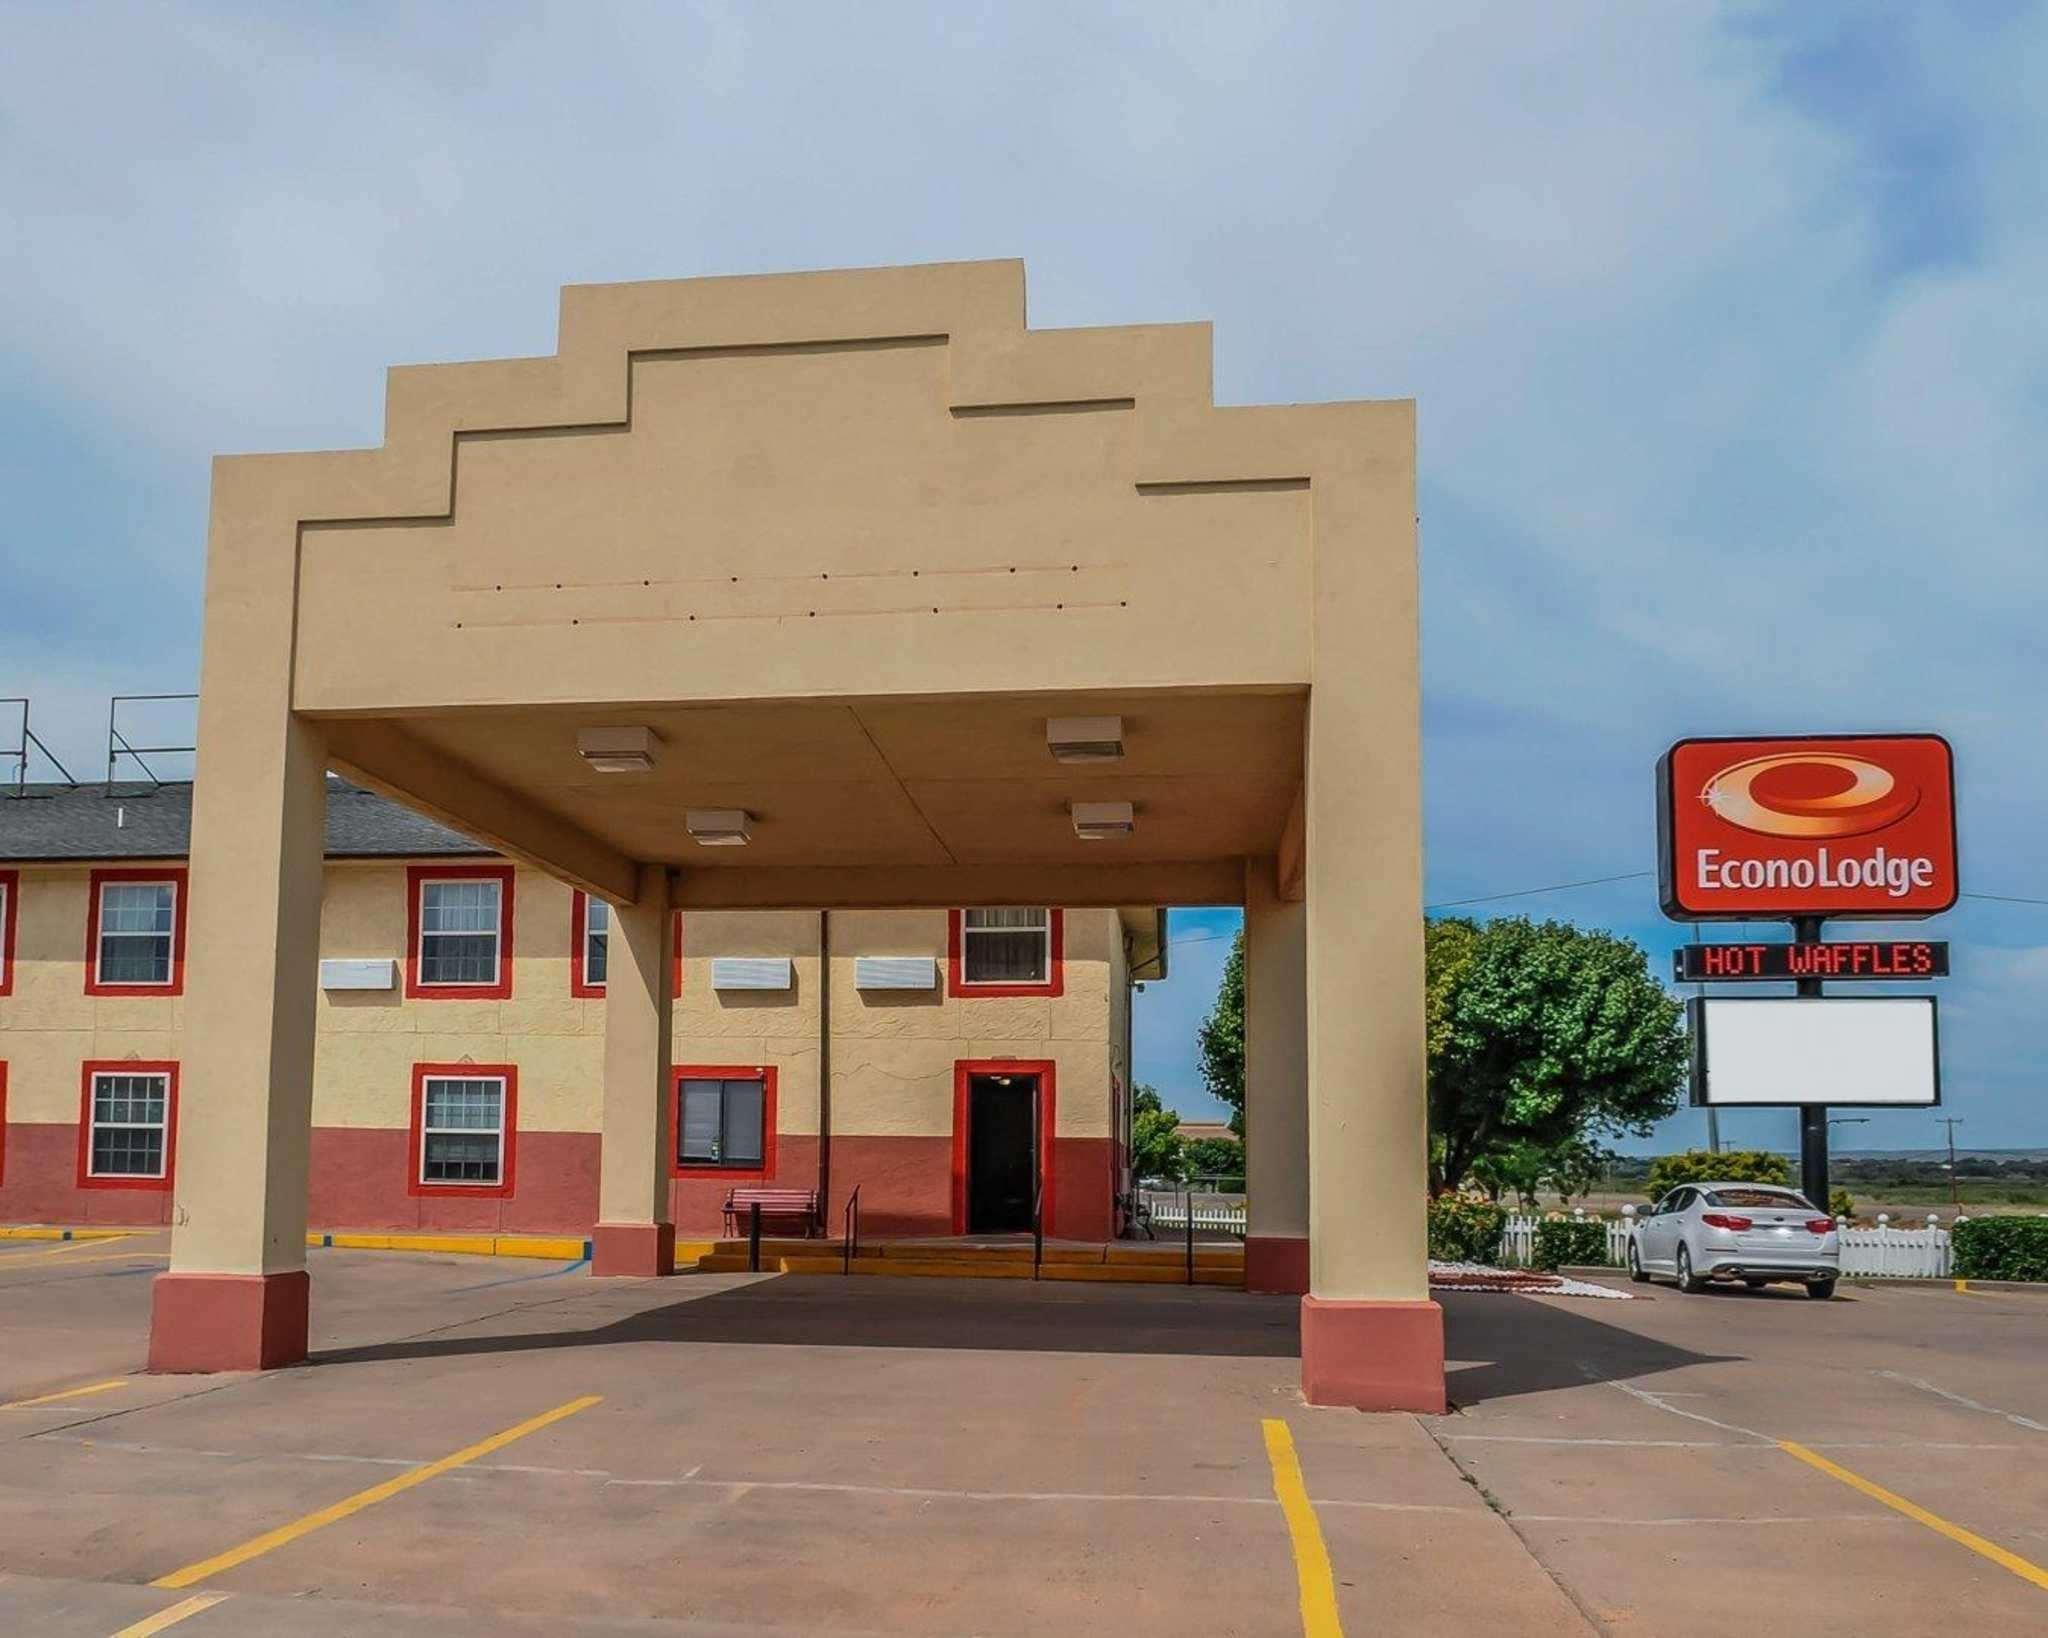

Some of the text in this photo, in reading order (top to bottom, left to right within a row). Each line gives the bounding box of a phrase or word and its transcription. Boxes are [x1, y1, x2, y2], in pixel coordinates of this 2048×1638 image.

[1697, 848, 1934, 896] EconoLodge
[1705, 944, 1931, 974] HOT WAFFLES
